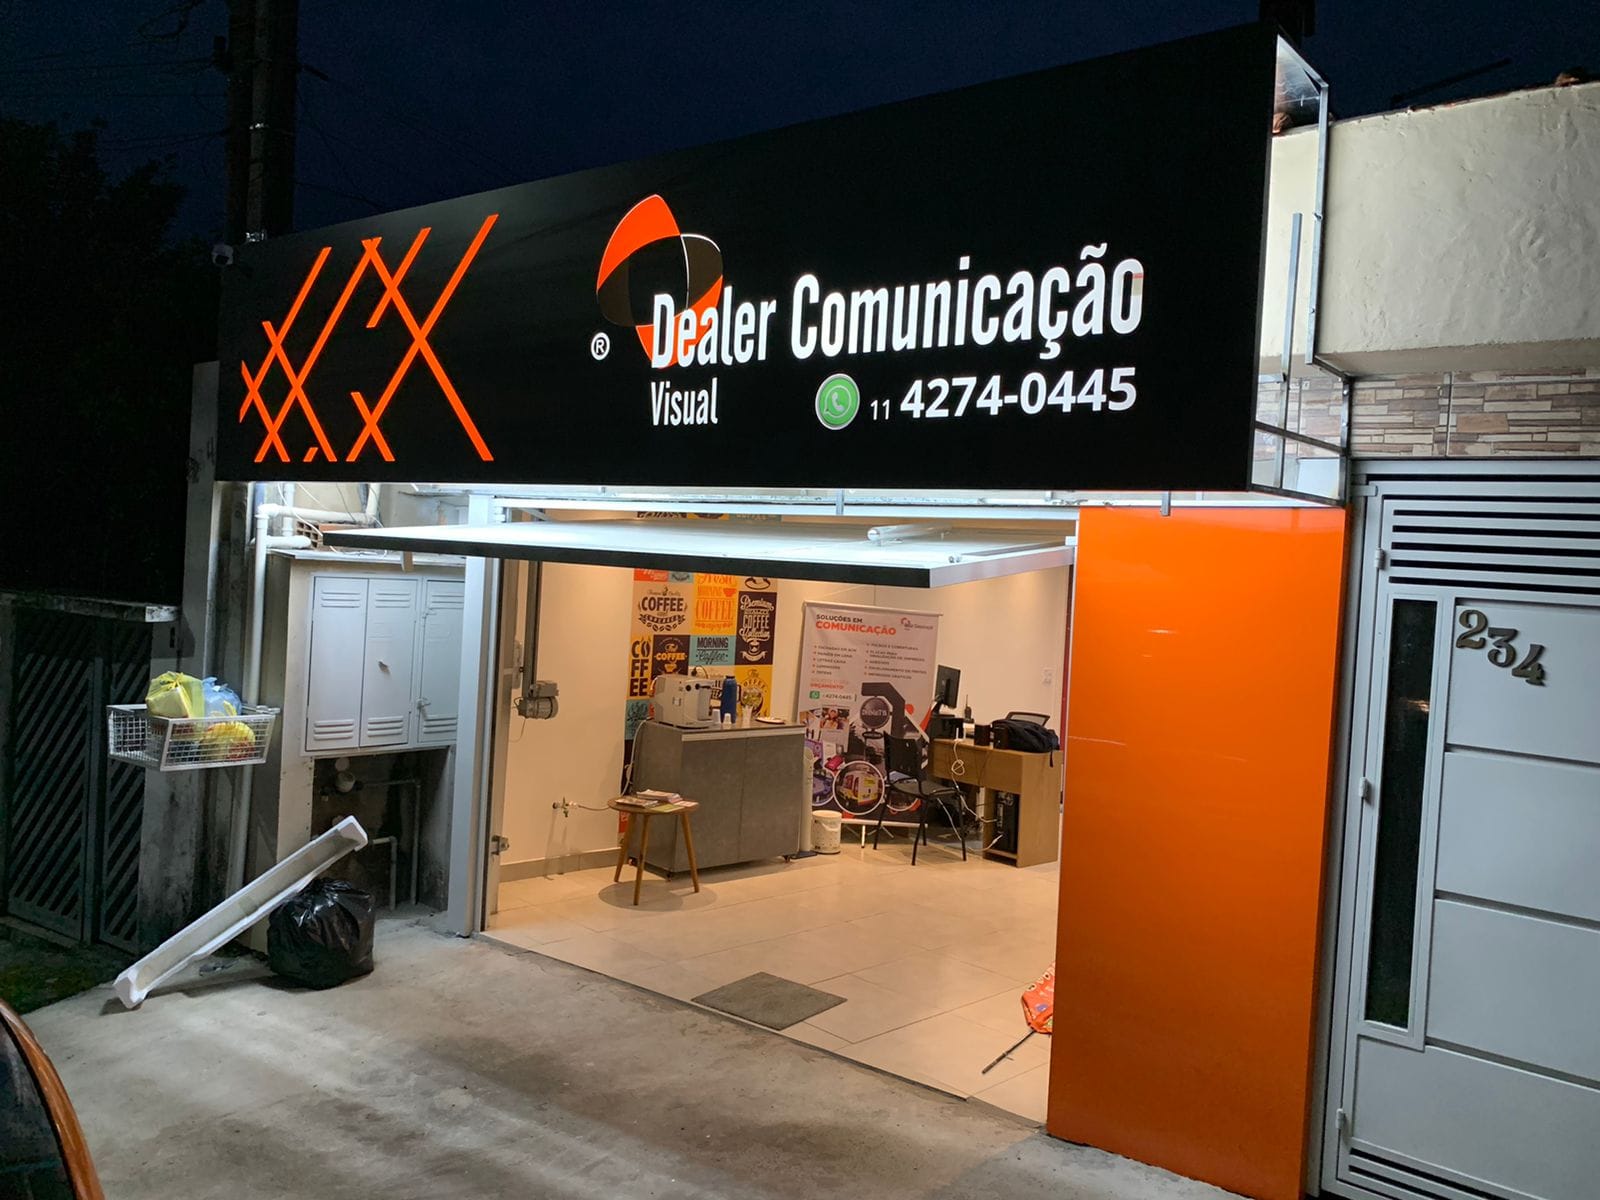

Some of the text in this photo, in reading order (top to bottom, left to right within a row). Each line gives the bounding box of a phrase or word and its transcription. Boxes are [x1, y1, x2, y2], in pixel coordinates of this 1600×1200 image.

[652, 242, 1145, 369] Dealer Comunicação
[869, 366, 1137, 420] 11 4274-0445
[650, 377, 718, 426] Visual
[641, 597, 684, 612] COFFEE
[742, 614, 771, 630] COFFEE
[816, 614, 851, 623] SOLUÇÕES
[815, 620, 897, 636] COMUNICAÇÃO
[697, 637, 729, 649] MORNING
[1456, 609, 1545, 687] 234
[656, 652, 686, 661] COFFEE
